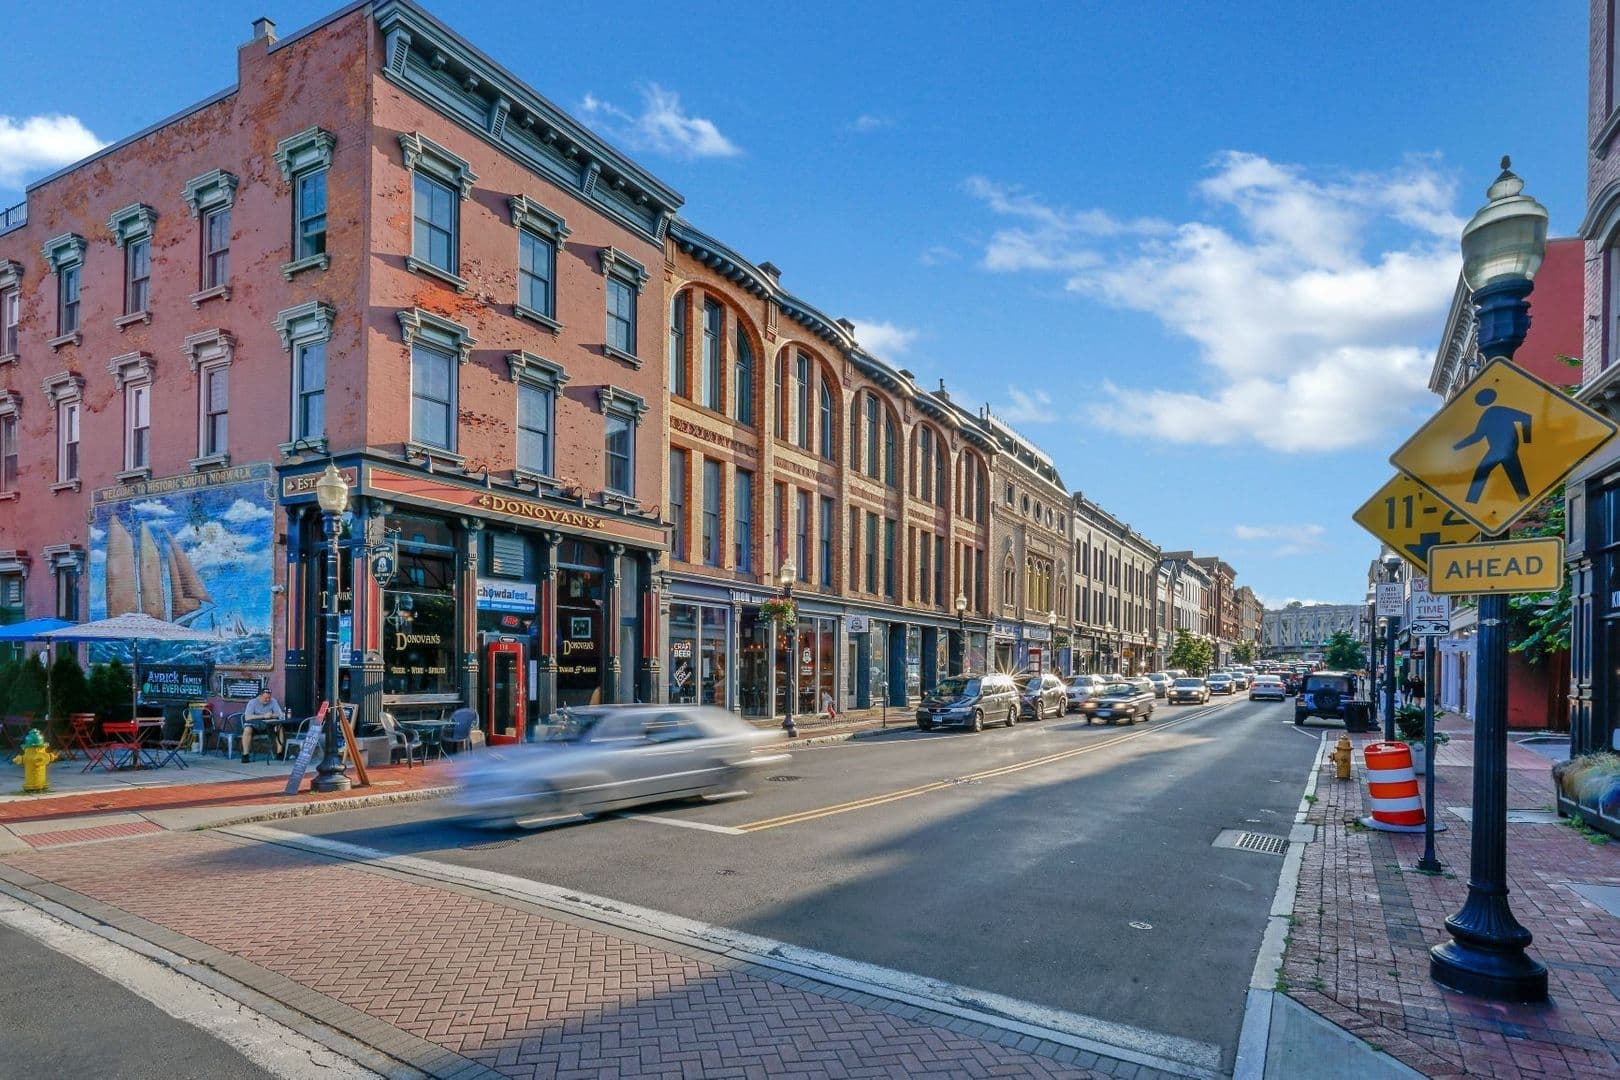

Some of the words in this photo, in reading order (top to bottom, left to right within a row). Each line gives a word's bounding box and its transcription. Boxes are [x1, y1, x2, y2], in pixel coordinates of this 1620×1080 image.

[102, 486, 136, 500] WELCOME
[138, 484, 147, 494] TO
[148, 479, 180, 493] HISTORIC
[182, 473, 208, 488] SOUTH
[210, 467, 251, 484] NORWALK
[492, 496, 595, 528] DONOVAN'S
[1445, 556, 1543, 579] AHEAD
[477, 587, 528, 600] chowdafest
[1418, 595, 1441, 604] ANY
[1416, 604, 1444, 614] TIME
[395, 632, 441, 651] DONOVAN'S
[674, 641, 691, 650] CRAFT
[674, 650, 691, 658] BEER
